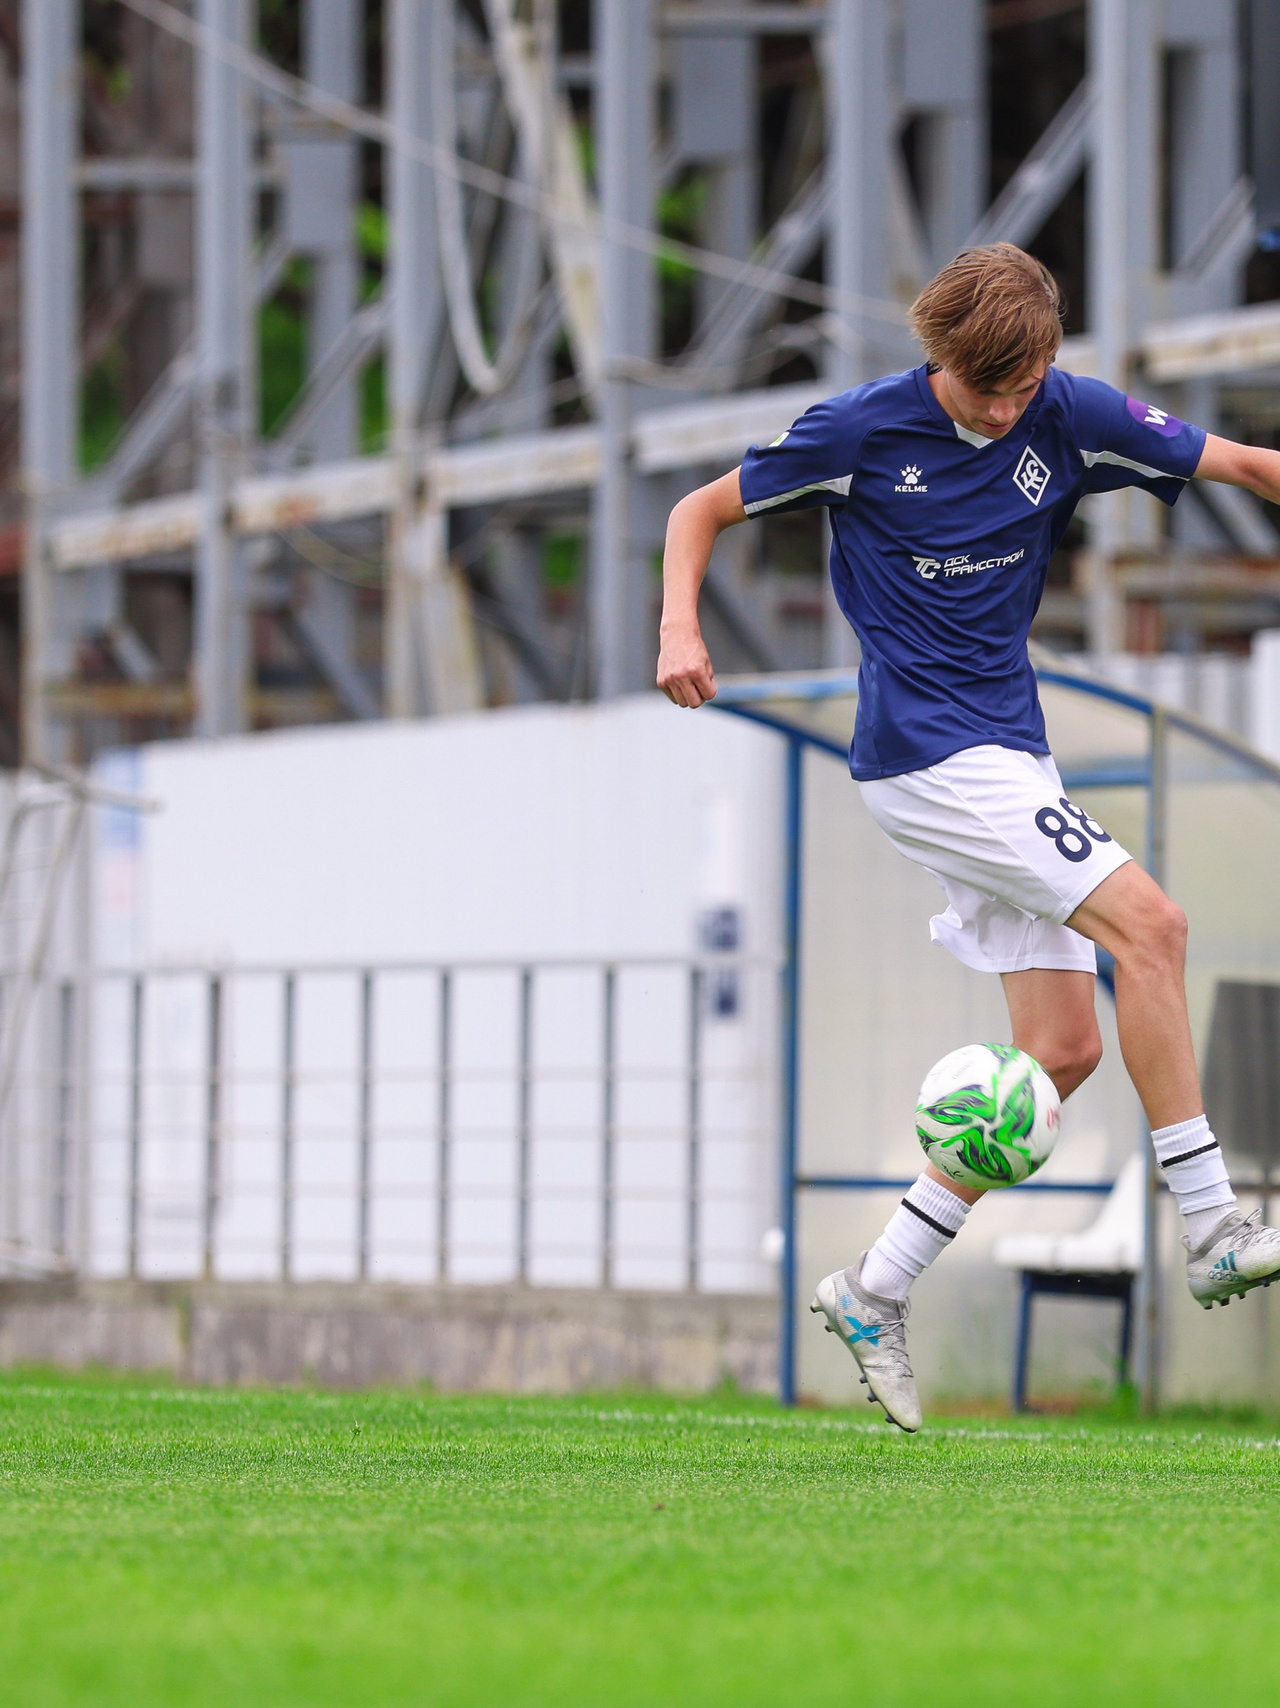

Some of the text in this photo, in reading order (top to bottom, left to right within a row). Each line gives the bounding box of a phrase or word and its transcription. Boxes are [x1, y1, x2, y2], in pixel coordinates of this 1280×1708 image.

[894, 484, 928, 493] KELME
[943, 554, 971, 568] ДСК
[943, 548, 1025, 578] ТРАНССТРОЙ
[1034, 797, 1113, 863] 88
